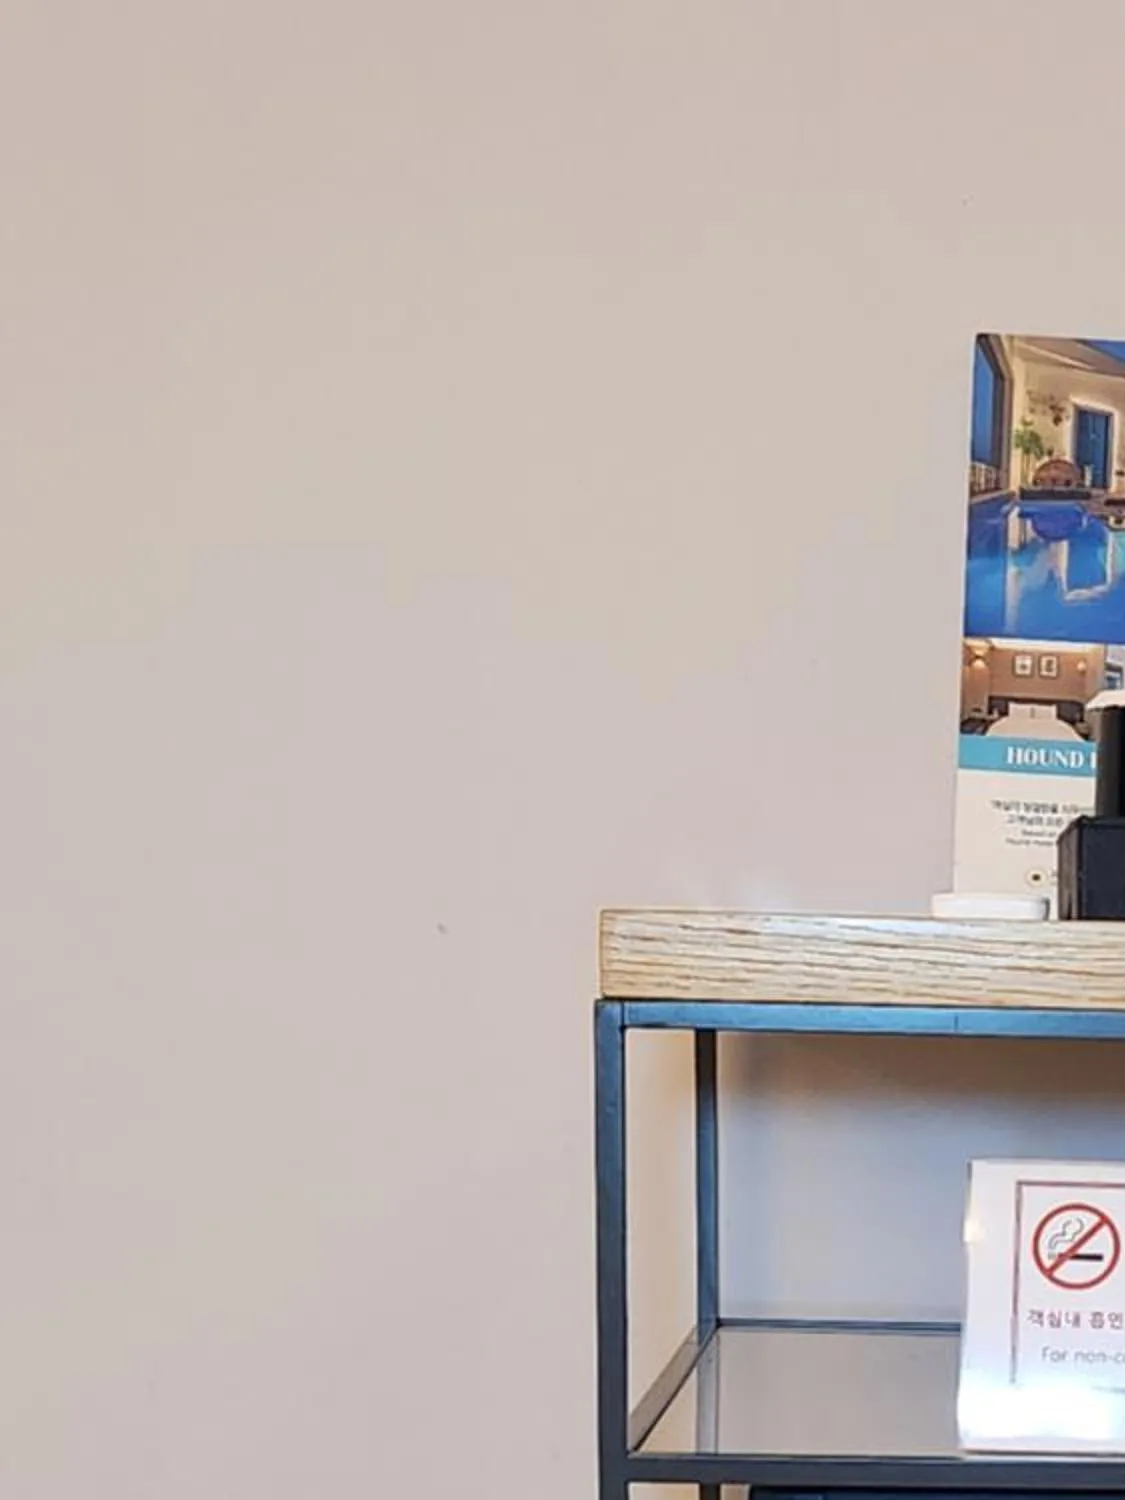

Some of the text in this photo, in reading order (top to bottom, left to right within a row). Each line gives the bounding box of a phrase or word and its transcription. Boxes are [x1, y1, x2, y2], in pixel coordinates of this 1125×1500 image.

[1006, 746, 1084, 768] HOUND
[1027, 1309, 1081, 1329] 객실내
[1041, 1346, 1068, 1363] For
